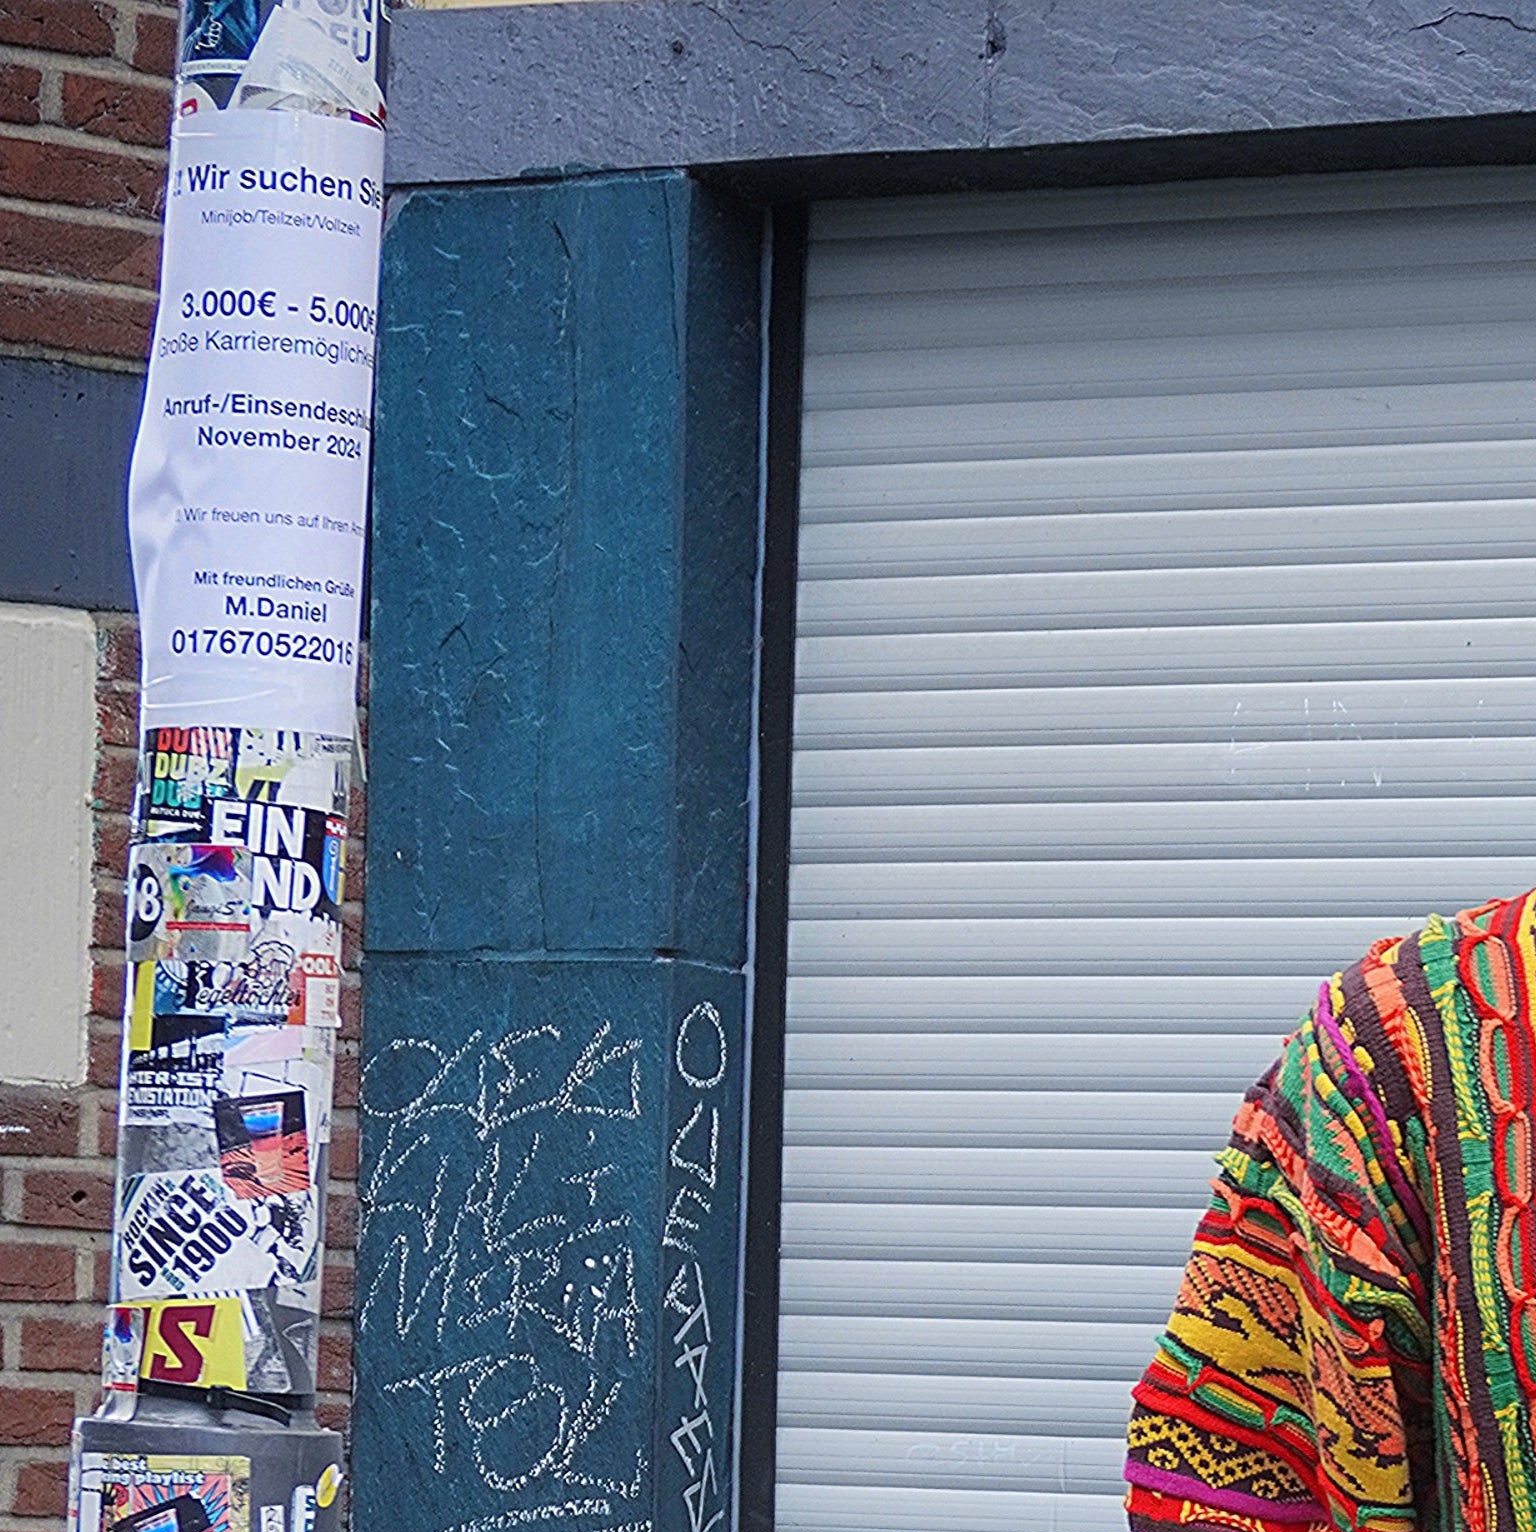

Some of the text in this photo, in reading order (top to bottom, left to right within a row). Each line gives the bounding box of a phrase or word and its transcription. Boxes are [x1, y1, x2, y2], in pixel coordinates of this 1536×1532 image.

[187, 164, 231, 193] Wir
[239, 166, 353, 201] suchen
[181, 290, 277, 319] 3.000€
[197, 426, 362, 460] November 2024
[212, 507, 261, 525] freuen
[265, 512, 293, 528] uns
[297, 514, 319, 529] auf
[194, 571, 219, 587] Mit
[222, 571, 323, 594] freundlichen
[225, 596, 329, 623] M.Daniel
[128, 1174, 217, 1287] SINCE
[171, 1205, 248, 1283] 1900
